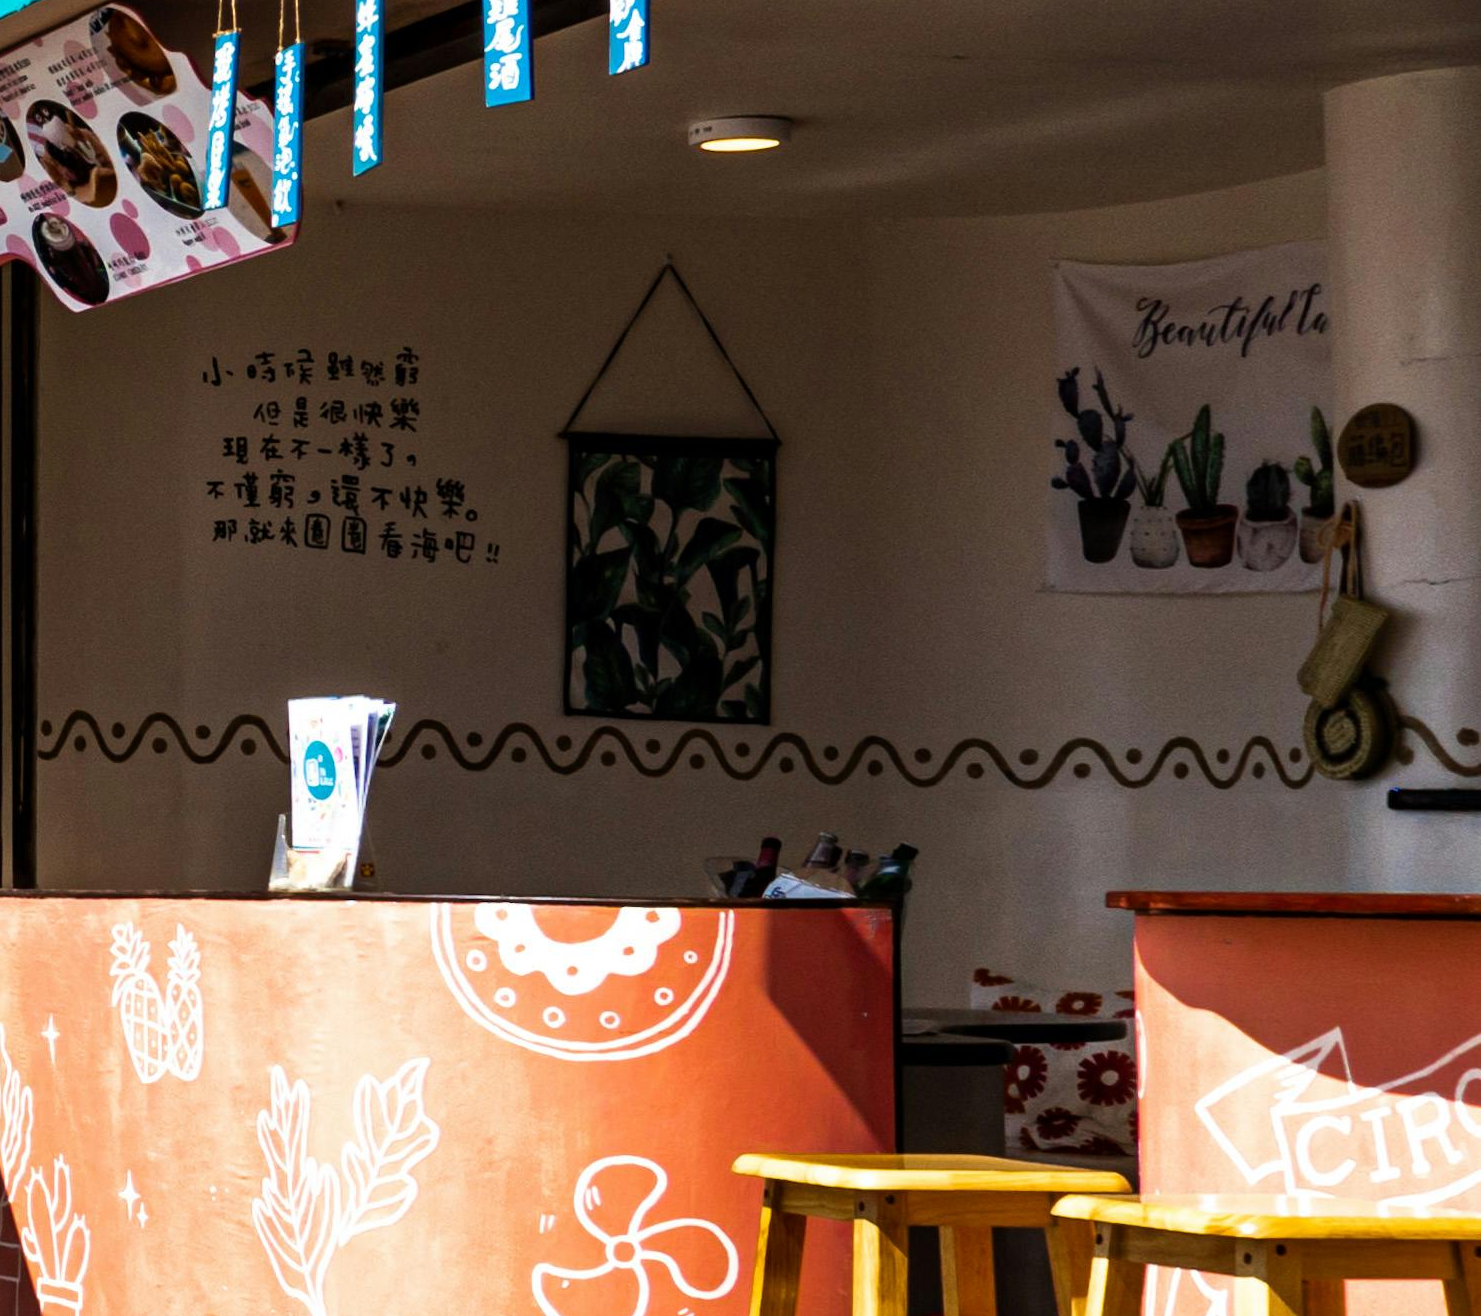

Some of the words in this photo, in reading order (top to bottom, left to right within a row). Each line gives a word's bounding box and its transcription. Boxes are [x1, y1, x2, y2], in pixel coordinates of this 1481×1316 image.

[1133, 287, 1294, 358] Beautiful
[253, 397, 420, 432] 但是很快樂
